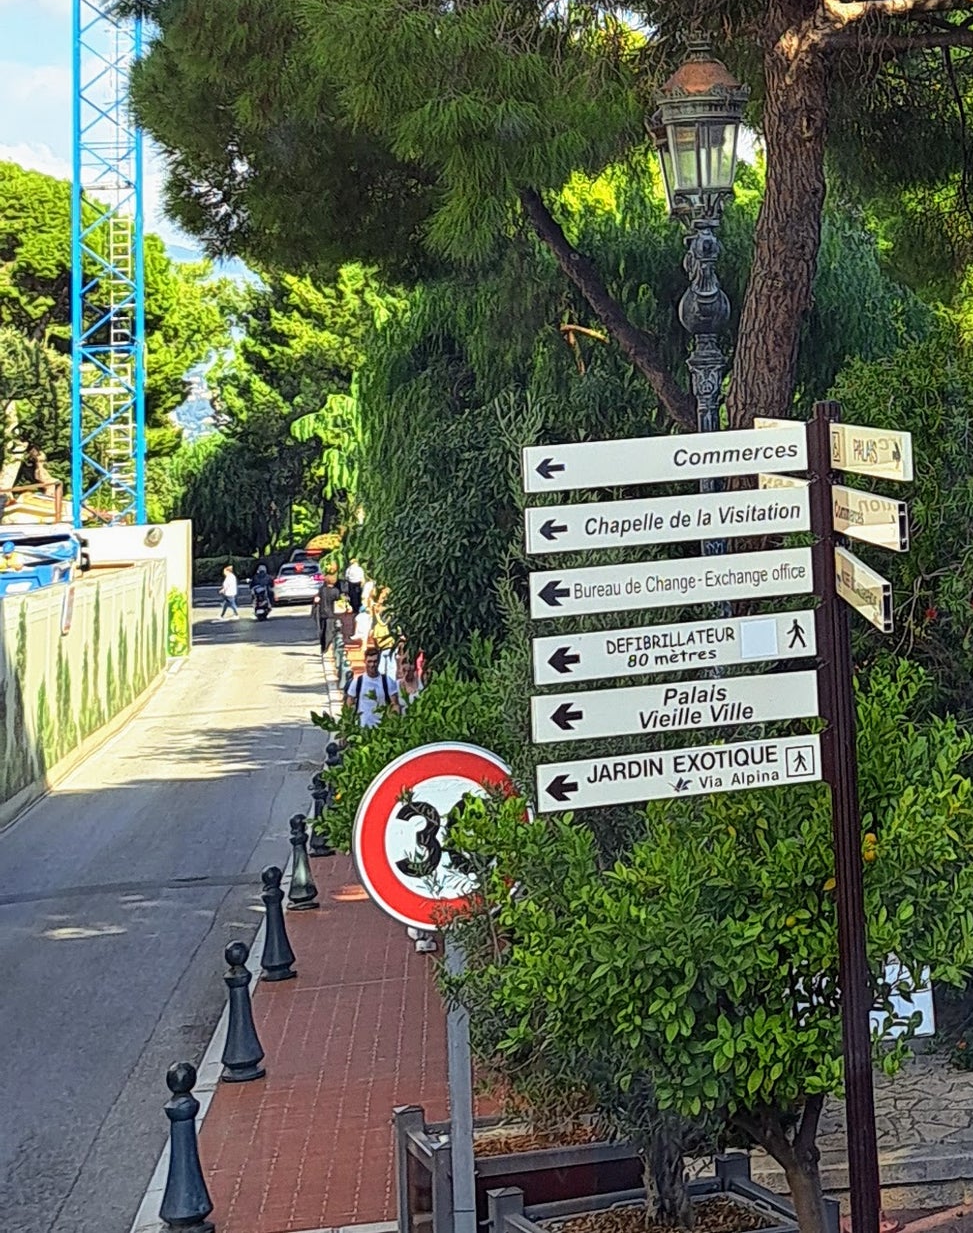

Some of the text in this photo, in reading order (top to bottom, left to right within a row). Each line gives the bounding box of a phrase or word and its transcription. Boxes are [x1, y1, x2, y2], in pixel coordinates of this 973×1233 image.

[673, 442, 799, 467] Commerces
[584, 503, 801, 538] Chapelle de la Visitation
[574, 582, 621, 600] Bureau
[625, 577, 642, 594] de
[645, 574, 696, 595] Change
[705, 568, 769, 588] Exchange
[772, 563, 806, 581] office
[606, 626, 735, 655] DEFIBRILLATEUR
[627, 646, 717, 668] 80 mètres
[663, 682, 728, 707] Palais
[638, 702, 754, 730] Vieille Ville
[586, 744, 778, 785] JARDIN EXOTIQUE
[699, 769, 780, 790] Via Alpina
